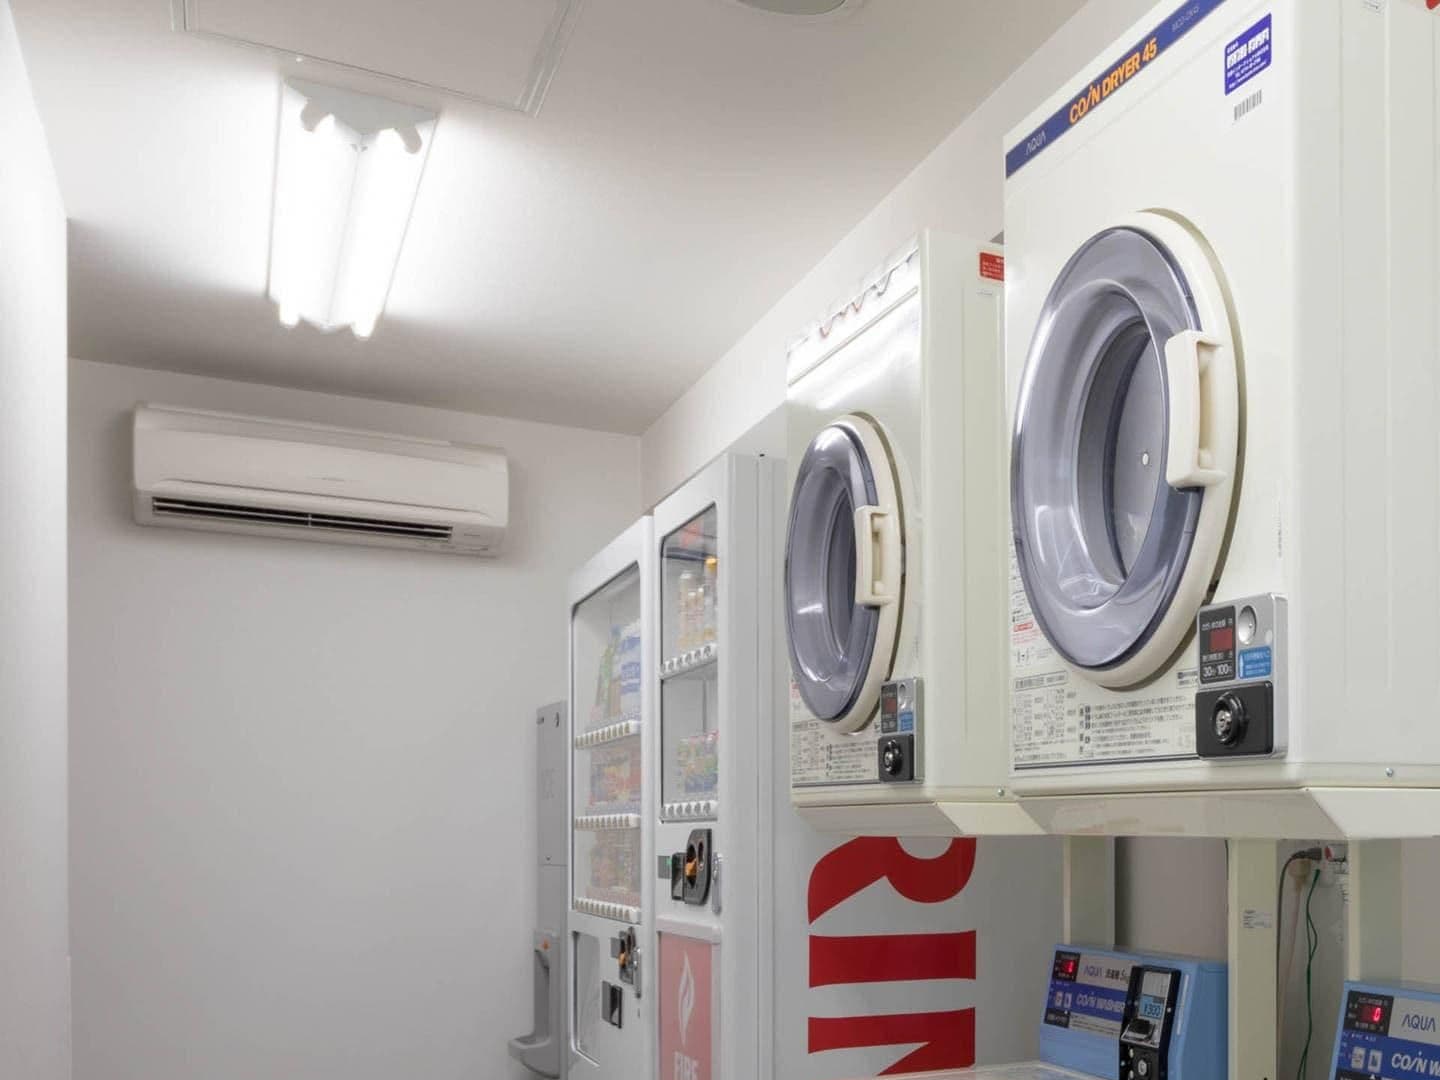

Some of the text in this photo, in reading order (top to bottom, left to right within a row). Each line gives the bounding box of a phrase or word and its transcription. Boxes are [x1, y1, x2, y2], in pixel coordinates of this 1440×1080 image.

[1102, 52, 1140, 97] DRYER
[1142, 37, 1157, 61] 45
[1401, 1013, 1436, 1033] AQUA
